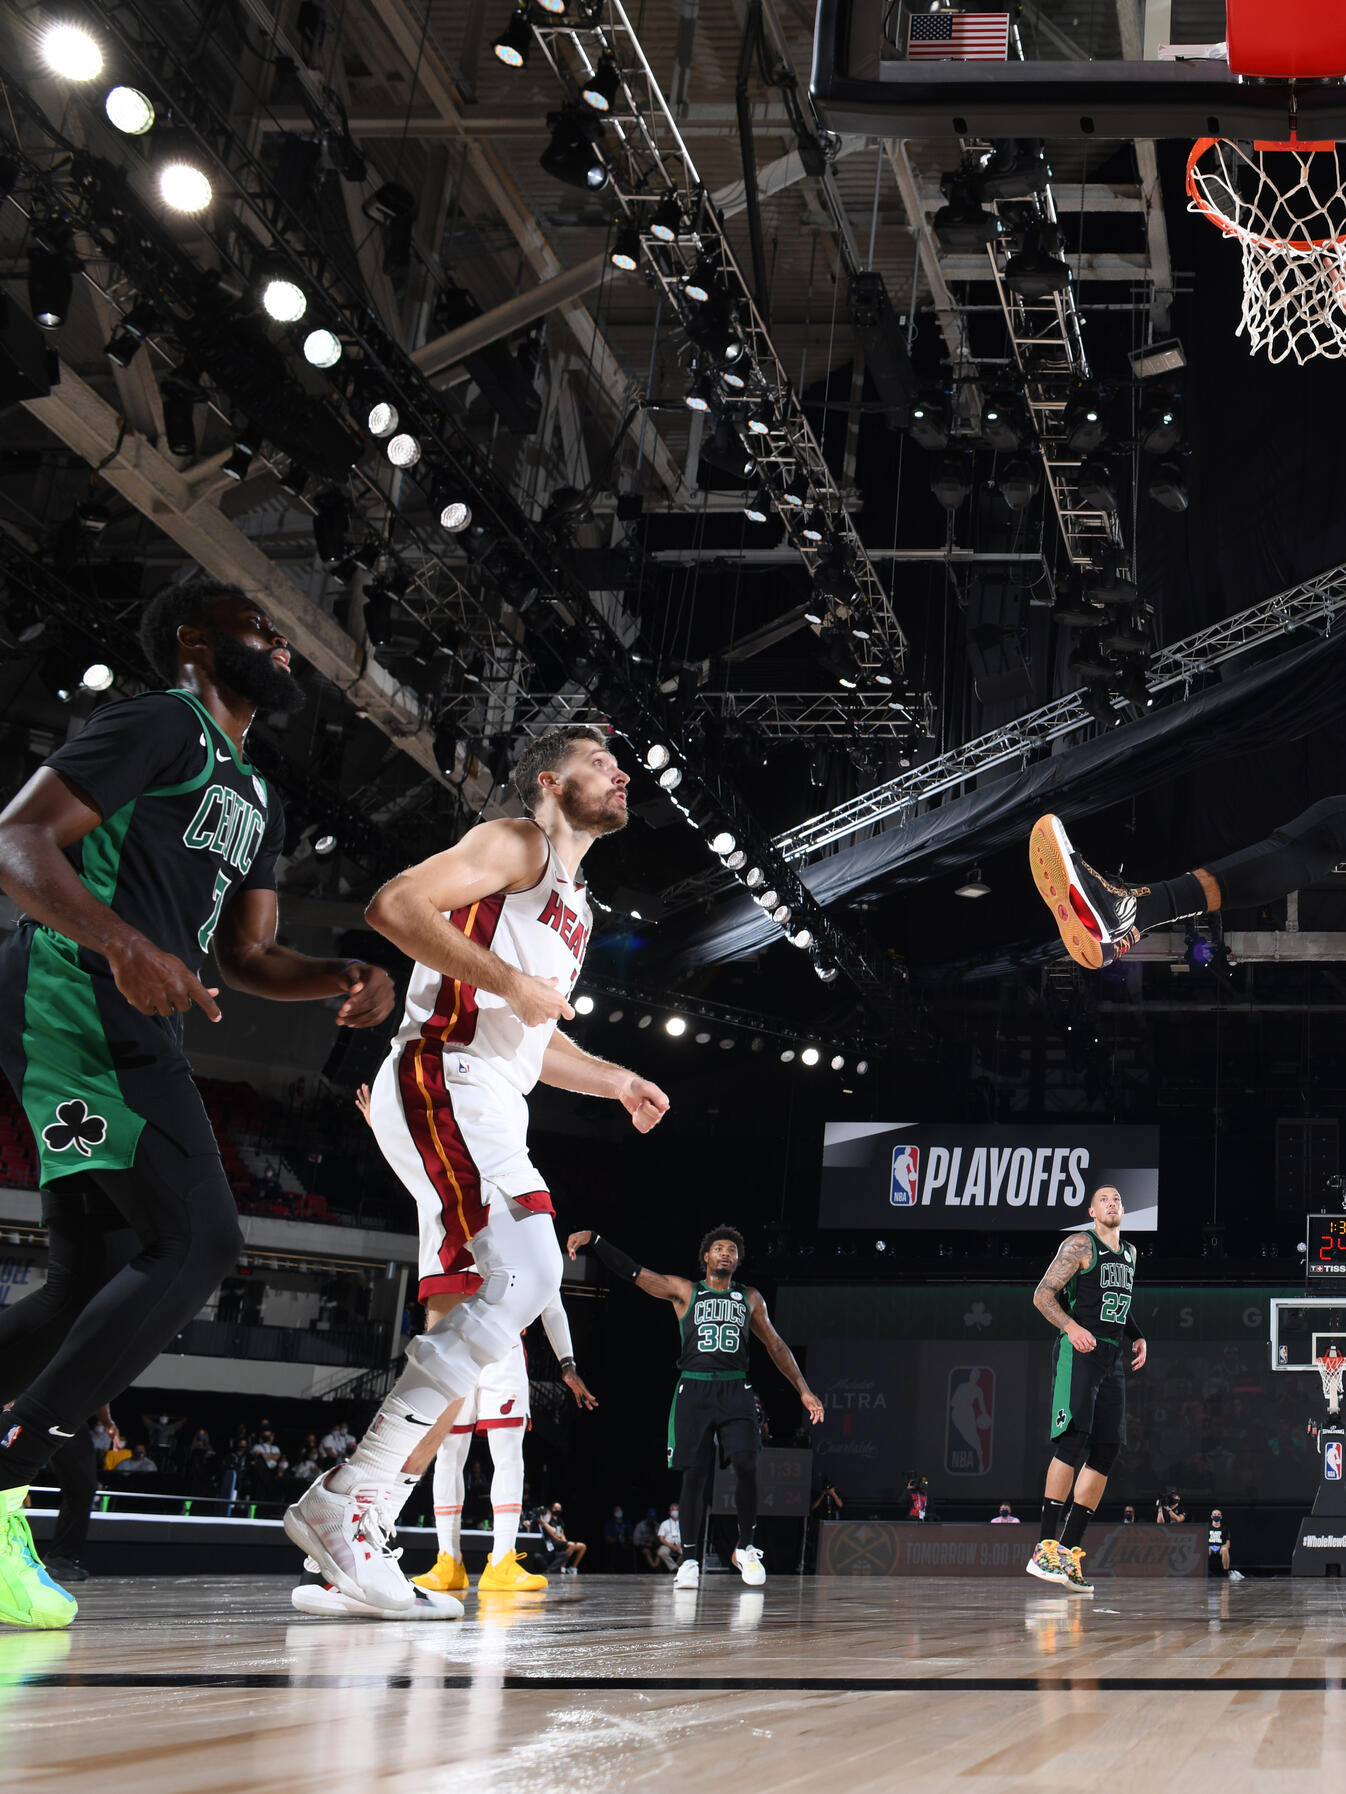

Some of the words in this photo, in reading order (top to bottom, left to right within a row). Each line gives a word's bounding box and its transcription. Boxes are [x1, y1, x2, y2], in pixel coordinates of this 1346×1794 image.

[182, 784, 266, 878] CELTIC
[197, 867, 232, 955] 7
[921, 1146, 1090, 1207] PLAYOFFS
[893, 1191, 907, 1203] NBA
[694, 1298, 747, 1328] CELTICS
[1100, 1291, 1132, 1325] 27
[697, 1323, 740, 1353] 36
[951, 1451, 974, 1469] NBA
[905, 1541, 978, 1565] TOMORROW
[980, 1541, 1009, 1565] 9:00
